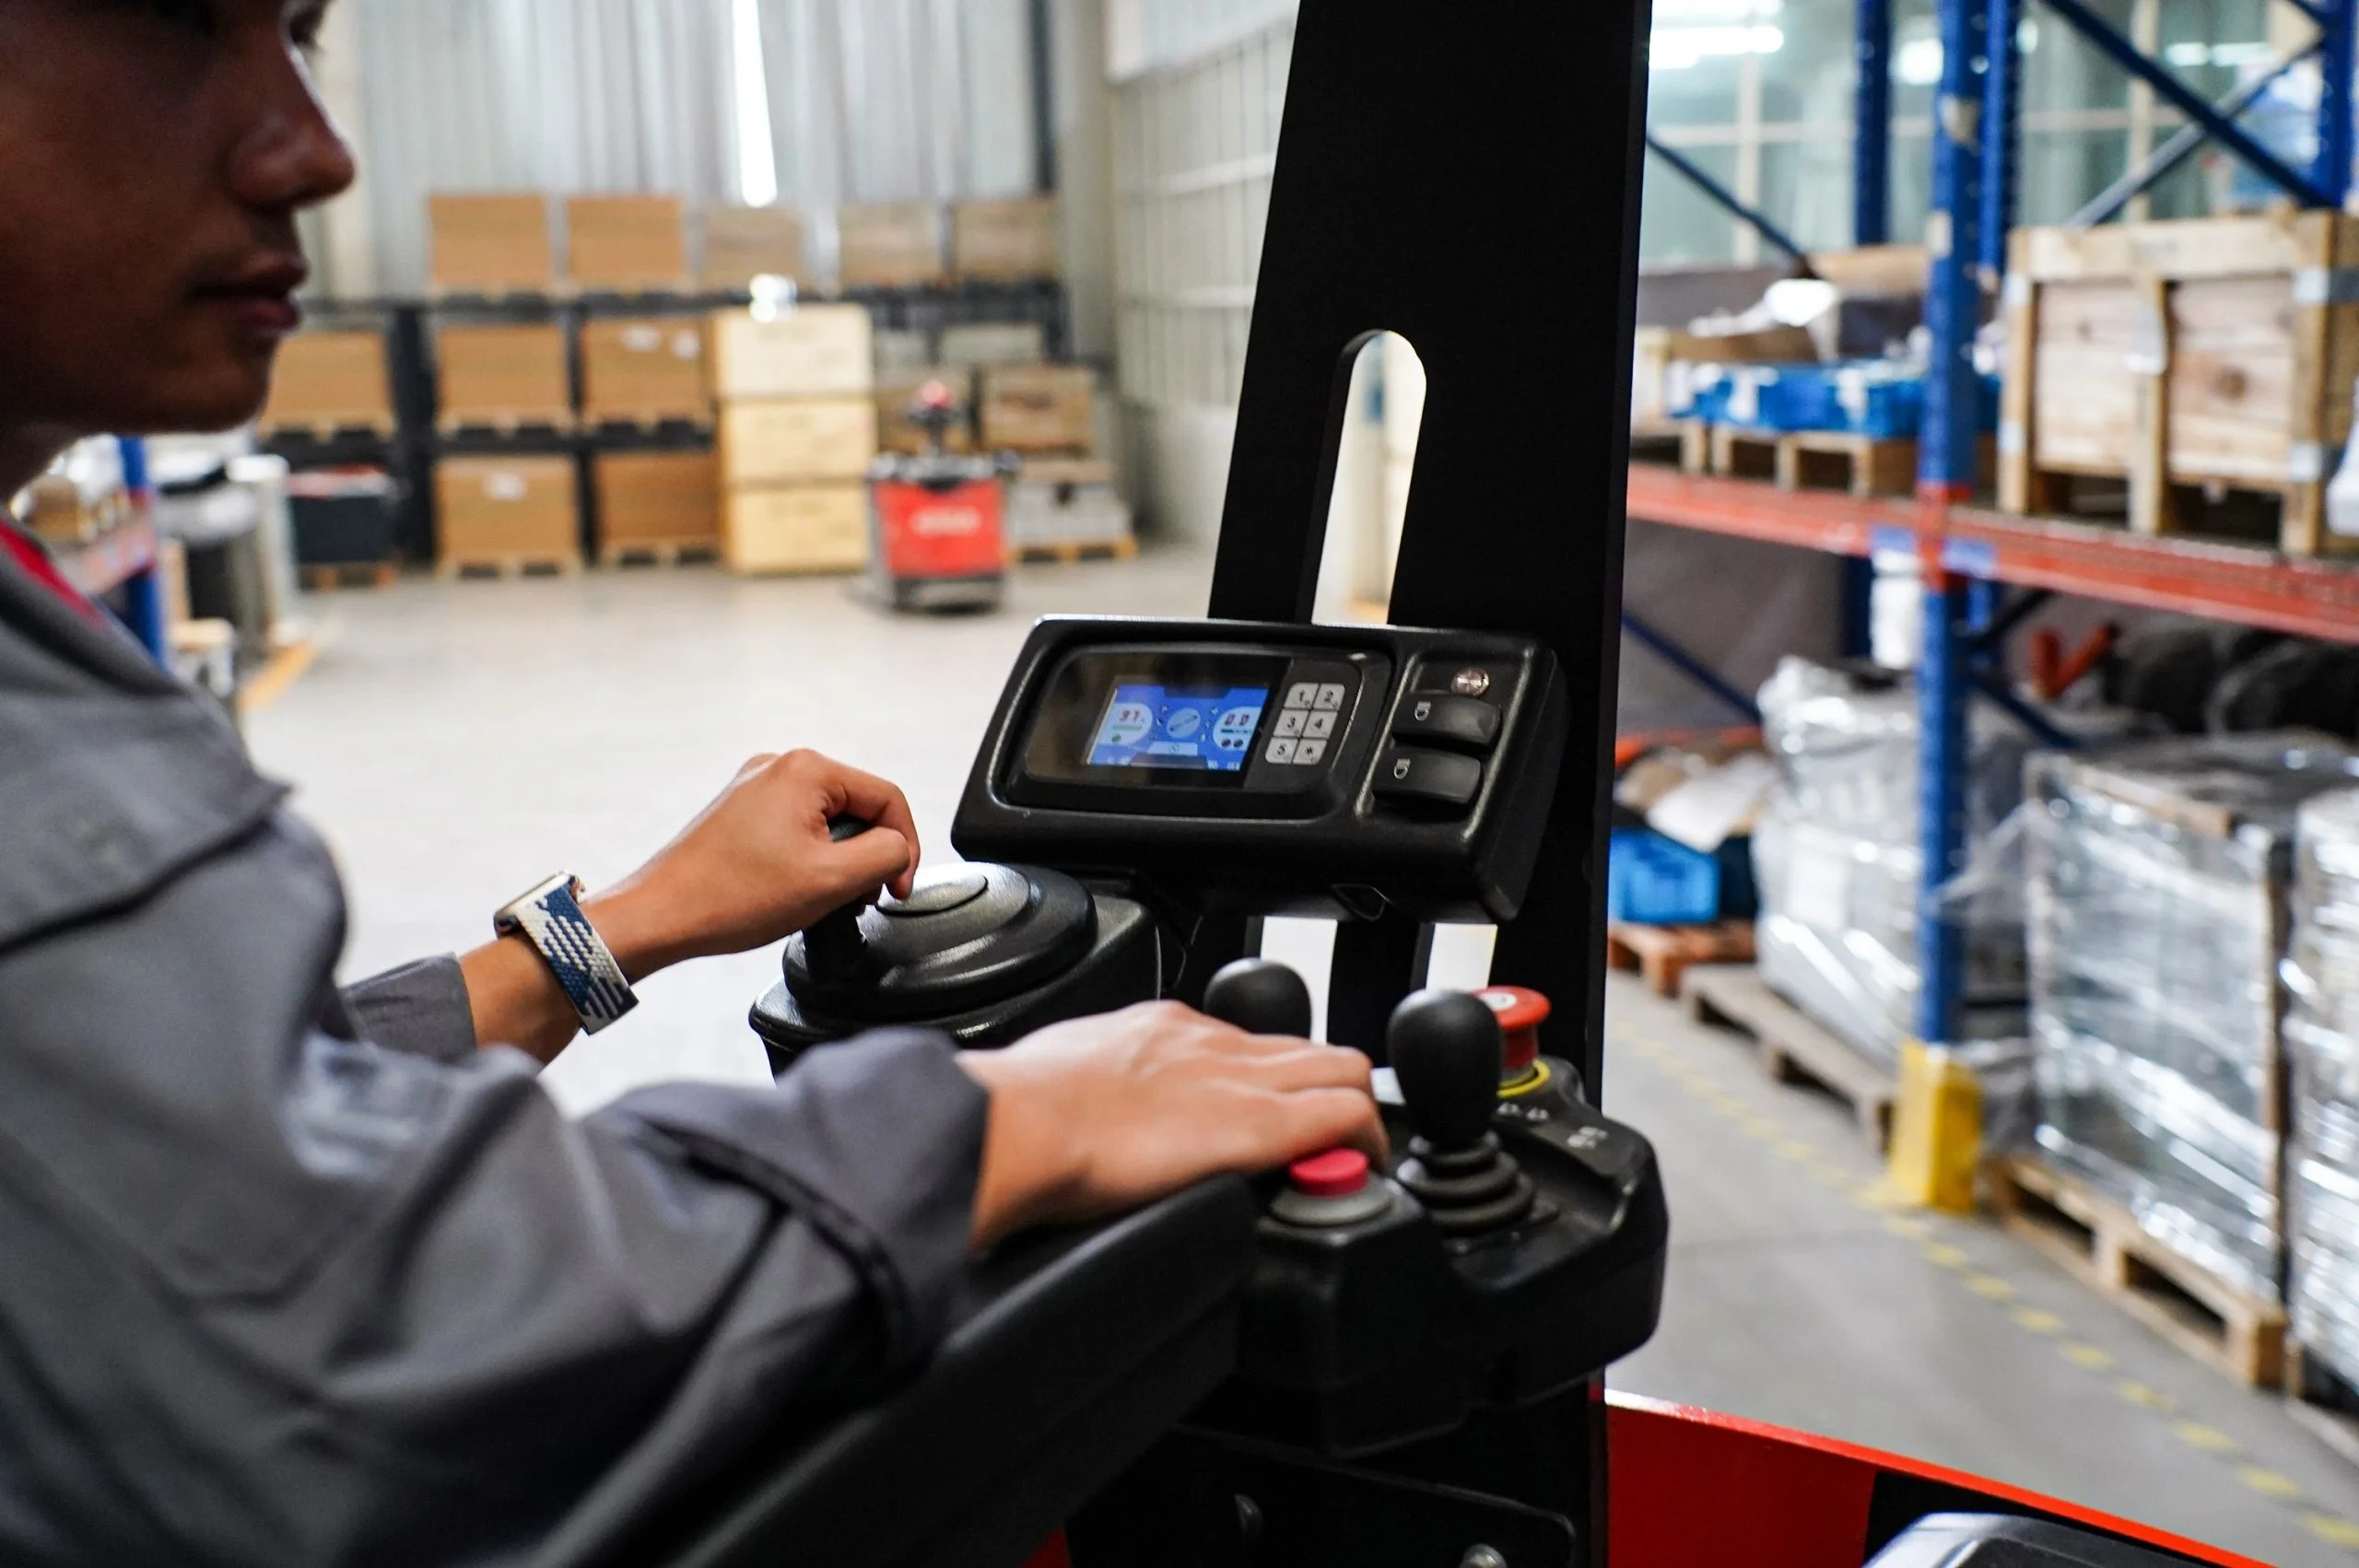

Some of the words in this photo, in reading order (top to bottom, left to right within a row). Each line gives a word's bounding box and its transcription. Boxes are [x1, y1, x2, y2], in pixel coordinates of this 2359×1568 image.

[1298, 689, 1305, 702] 1
[1324, 690, 1334, 703] 2
[1286, 717, 1297, 730] 3
[1314, 718, 1323, 730] 4
[1276, 743, 1286, 755] 5
